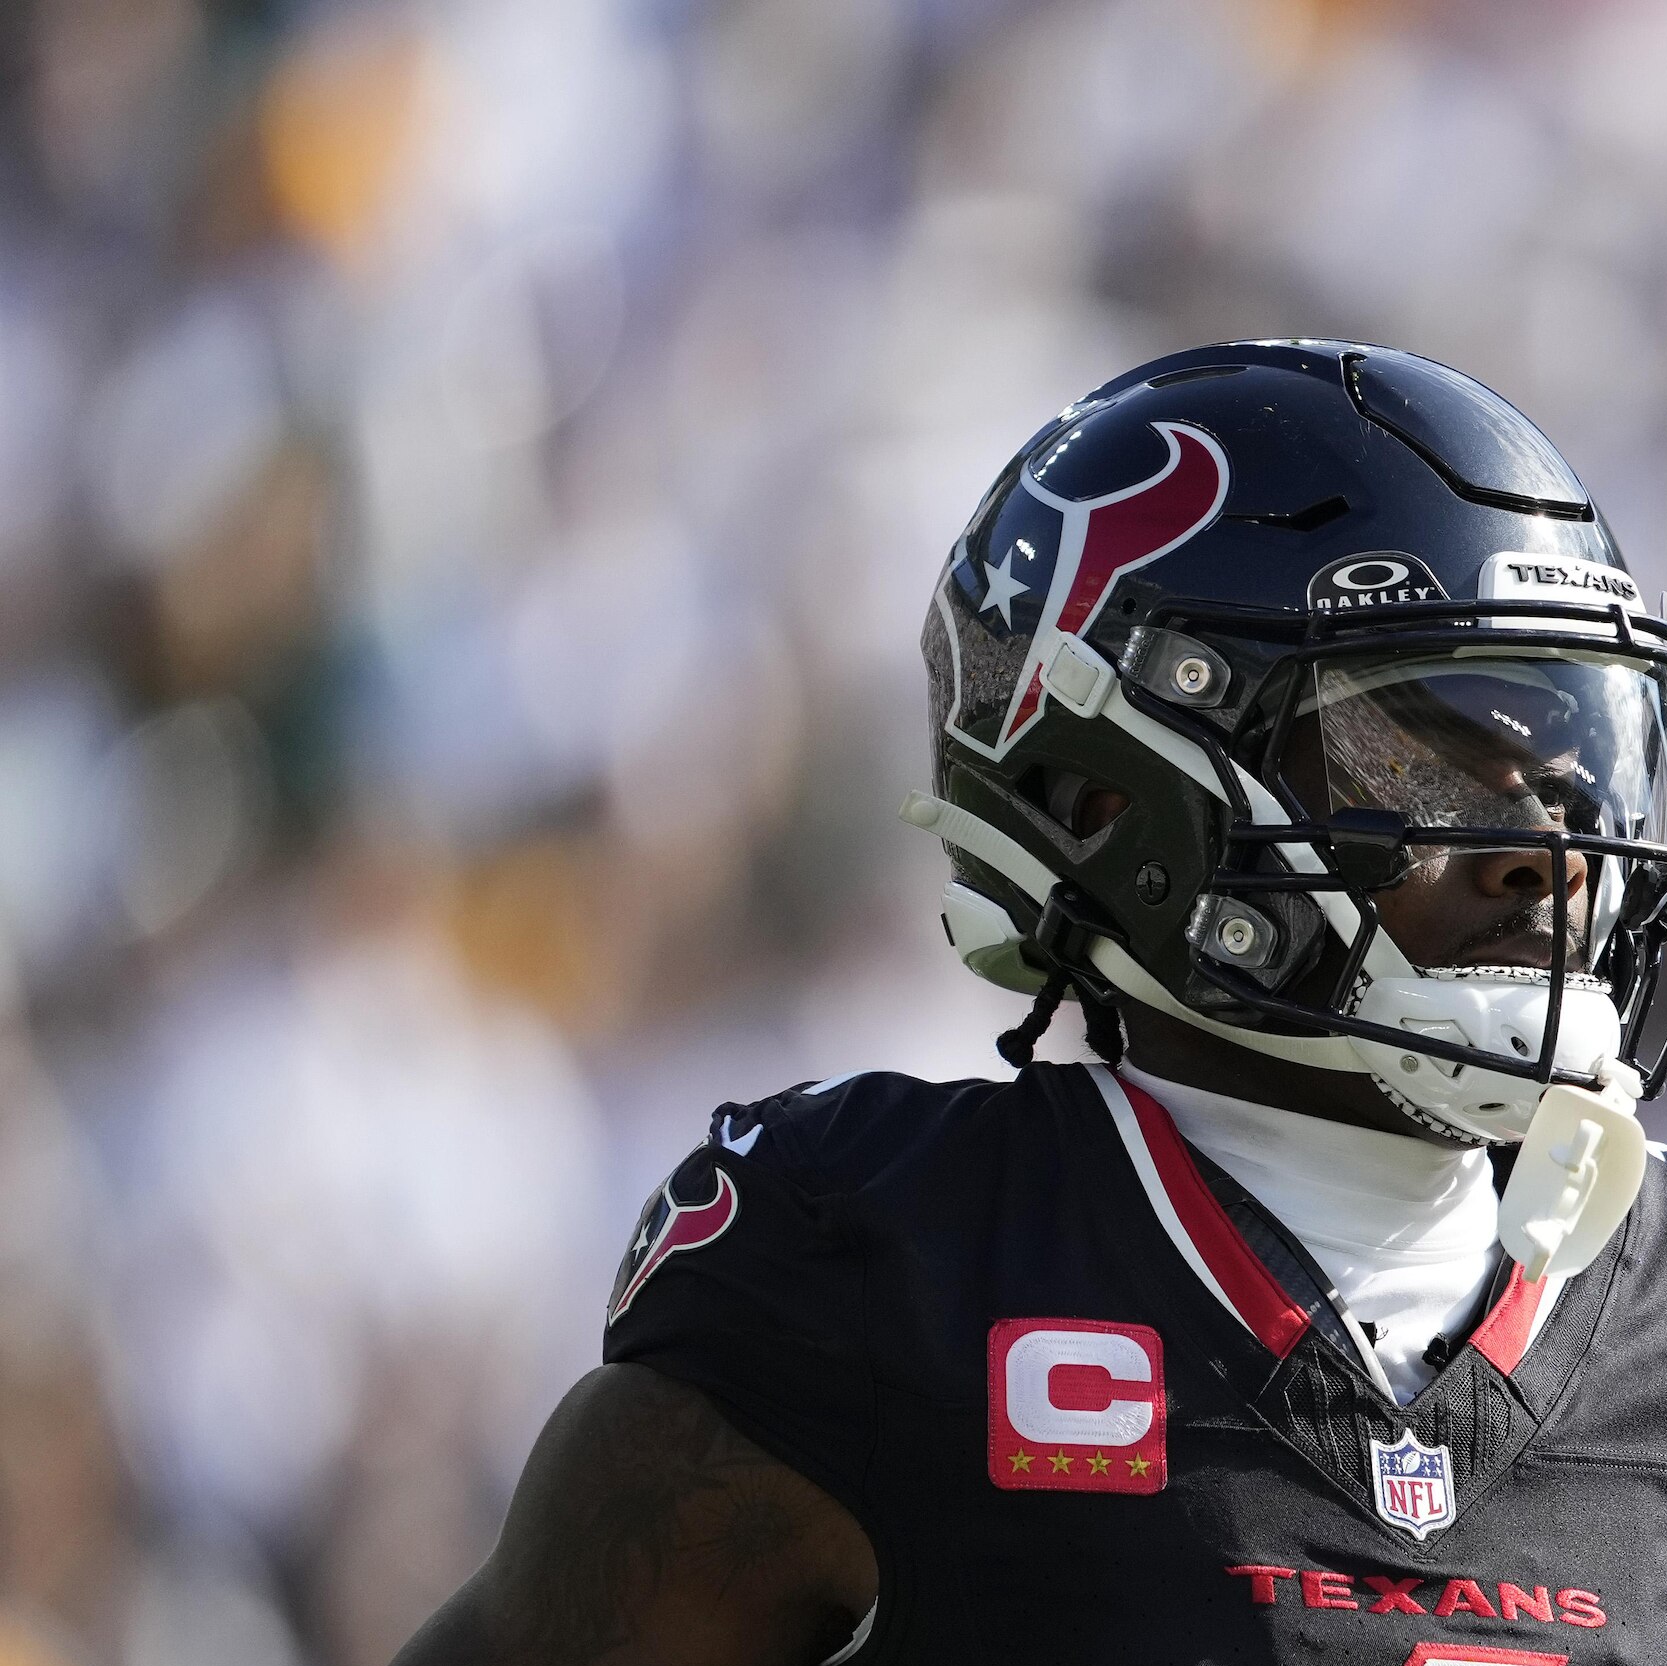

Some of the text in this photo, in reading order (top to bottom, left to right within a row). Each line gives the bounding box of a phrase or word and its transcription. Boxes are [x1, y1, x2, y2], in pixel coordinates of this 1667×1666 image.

[1316, 586, 1431, 609] OAKLEY
[1507, 564, 1638, 601] TEXANS
[1006, 1330, 1153, 1447] C
[1386, 1479, 1443, 1519] NFL
[1224, 1564, 1608, 1629] TEXANS
